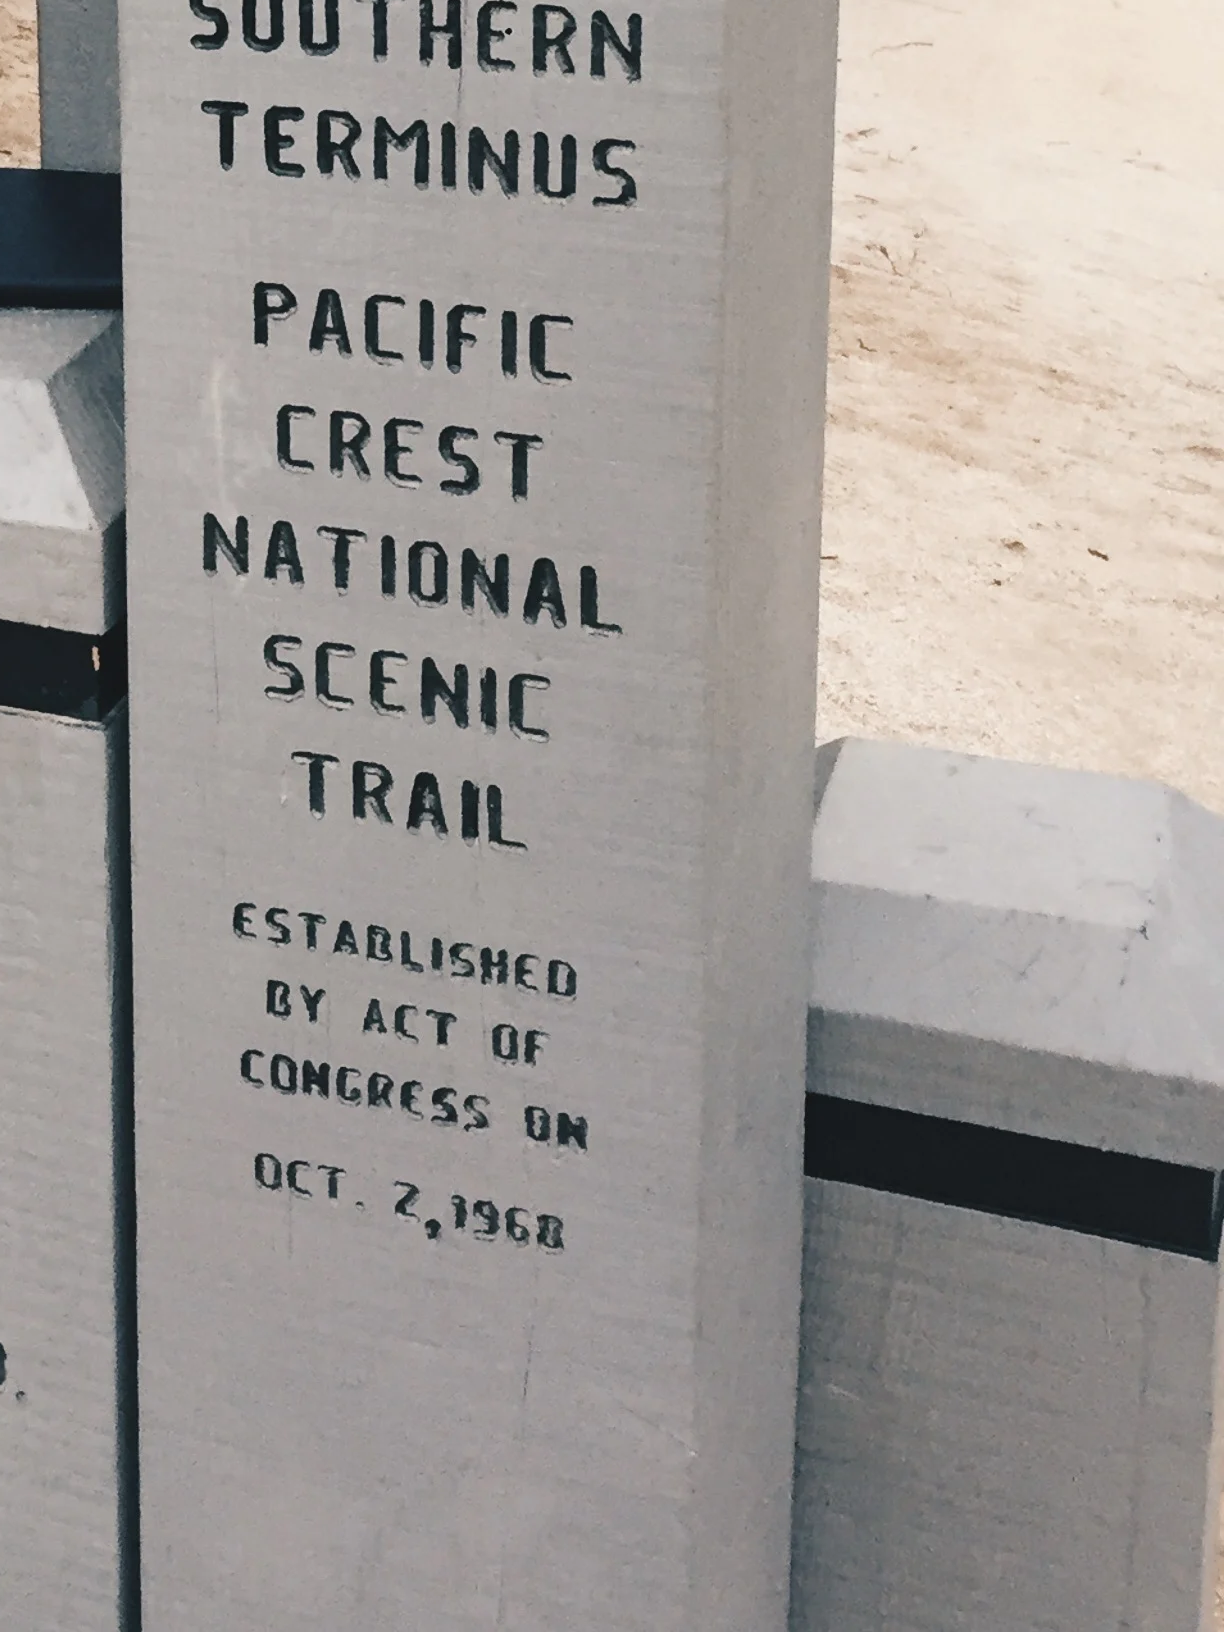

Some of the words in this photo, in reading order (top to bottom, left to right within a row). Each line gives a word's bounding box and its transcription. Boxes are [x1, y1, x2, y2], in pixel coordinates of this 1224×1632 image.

[200, 99, 638, 207] TERMINUS
[252, 280, 574, 384] PACIFIC
[276, 403, 544, 503] CREST
[202, 511, 623, 635] NATIONAL
[263, 634, 551, 738] SCENIC
[290, 750, 528, 851] TRAIL
[232, 902, 577, 1001] ESTABLISHED
[266, 979, 327, 1023] BY
[362, 998, 458, 1047] ACT
[491, 1023, 551, 1067] OF
[240, 1049, 491, 1134] CONGRESS
[523, 1105, 588, 1153] ON
[254, 1152, 366, 1212] OCT.
